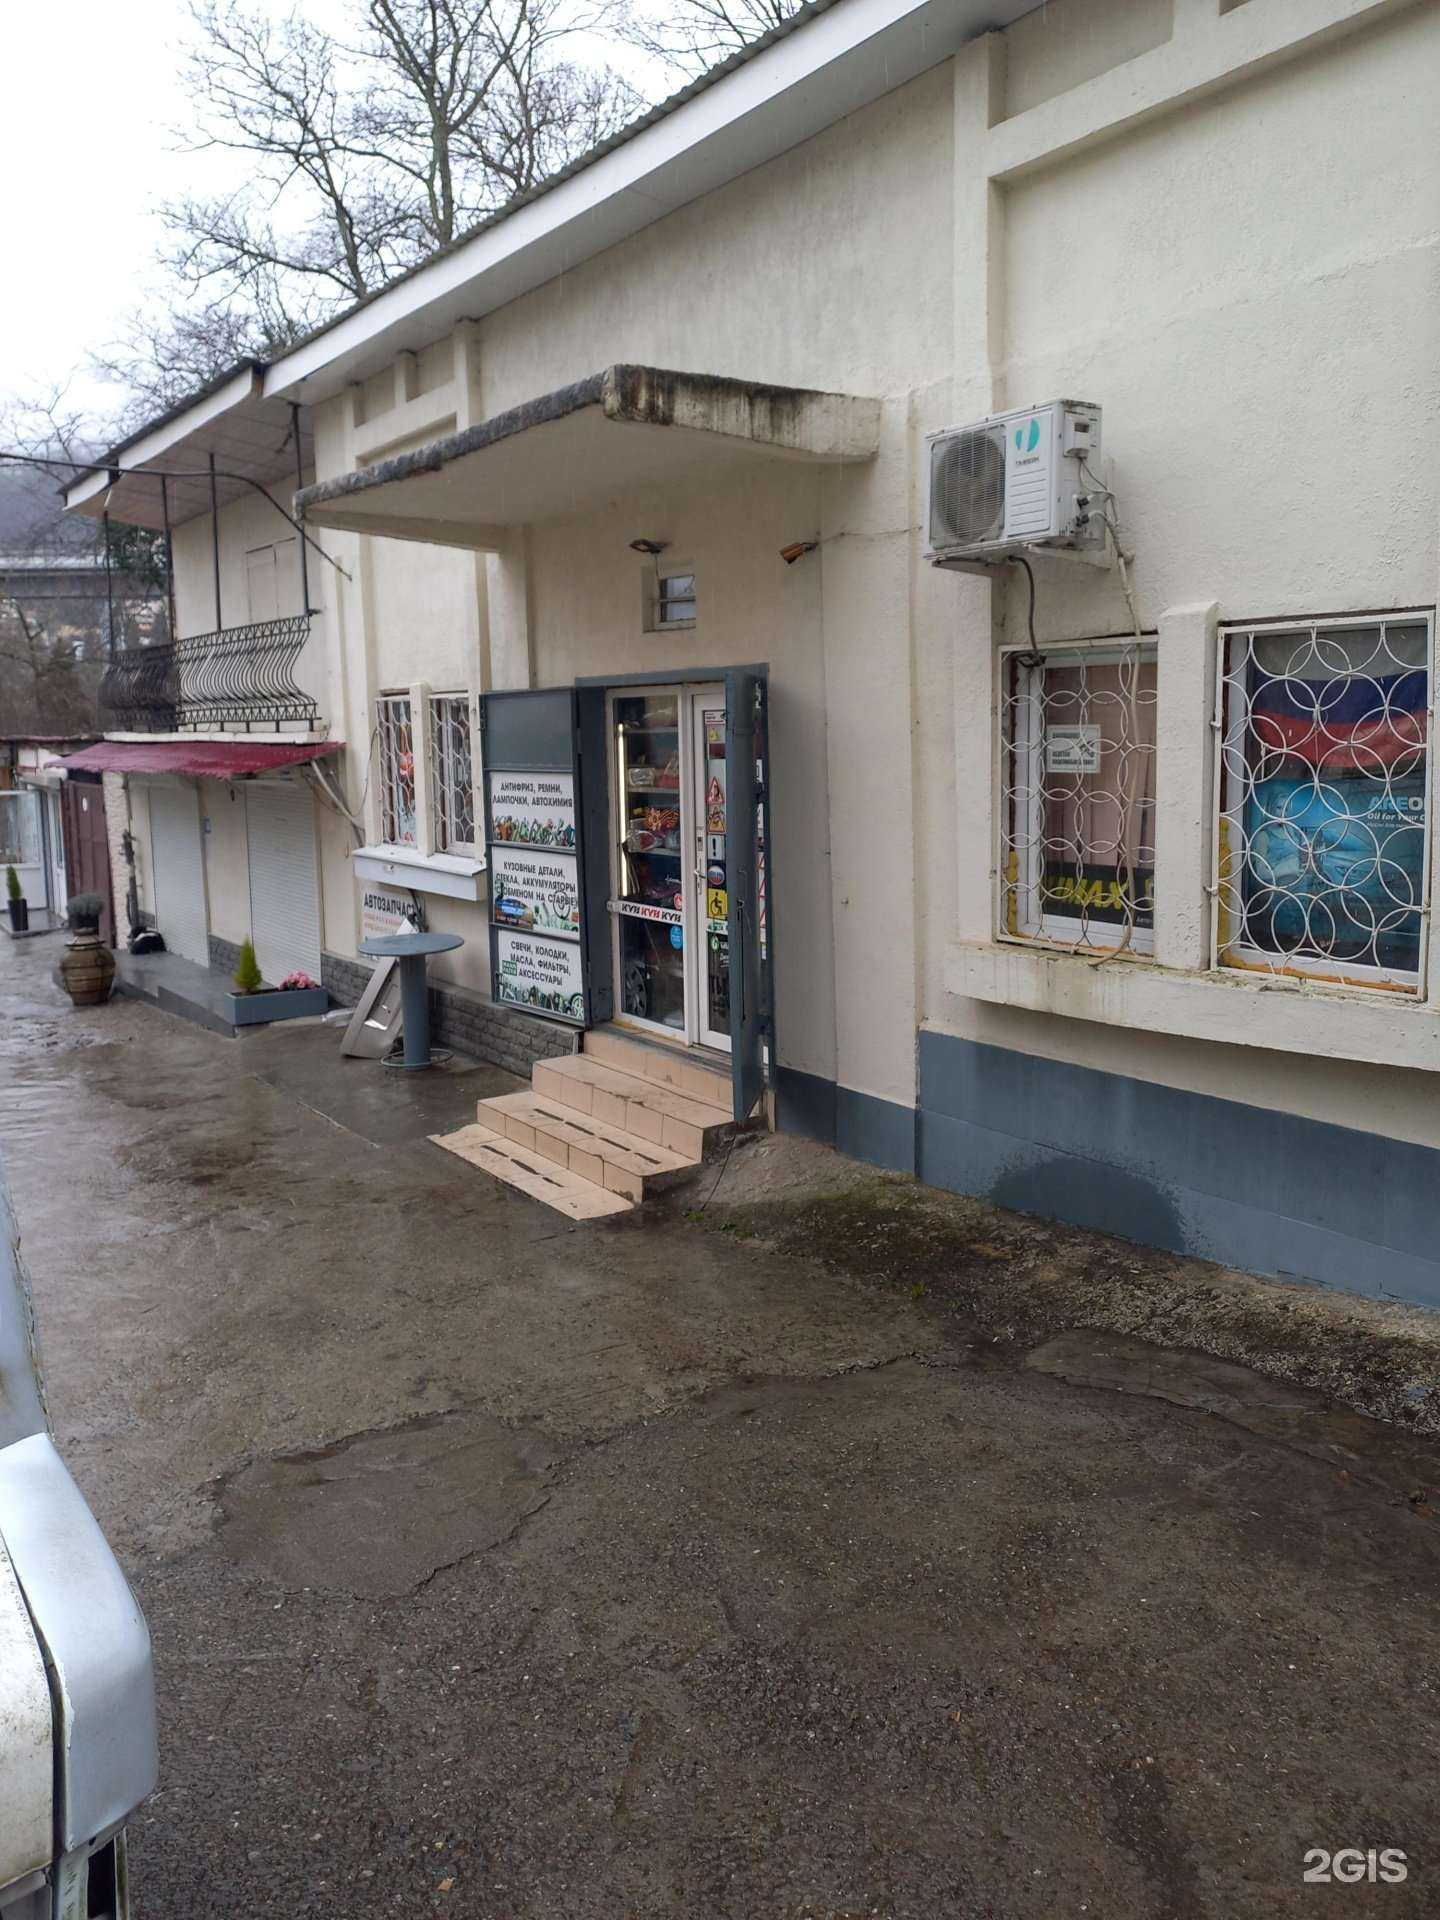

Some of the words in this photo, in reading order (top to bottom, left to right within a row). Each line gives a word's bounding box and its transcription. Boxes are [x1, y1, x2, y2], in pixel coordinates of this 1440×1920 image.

[500, 782, 535, 794] АНТИФРИЗ,
[537, 783, 562, 795] РЕМНИ,
[493, 795, 529, 806] ЛАМПОЧКИ,
[531, 797, 573, 808] АВТОХИМИЯ
[1368, 796, 1424, 811] AREO
[503, 861, 536, 874] КУЗОВНЫЕ
[538, 865, 565, 879] ДЕТАЛИ,
[495, 873, 520, 886] СТЕКЛА,
[522, 877, 576, 893] АККУМУЛЯТОРЫ
[502, 887, 534, 900] ОБМЕНОМ
[535, 891, 545, 901] НА
[510, 941, 533, 955] СВЕЧИ,
[535, 945, 570, 962] КОЛОДКИ,
[510, 953, 536, 969] МАСЛА,
[537, 959, 571, 976] ФИЛЬТРЫ,
[518, 968, 563, 986] АКСЕССУАРЫ
